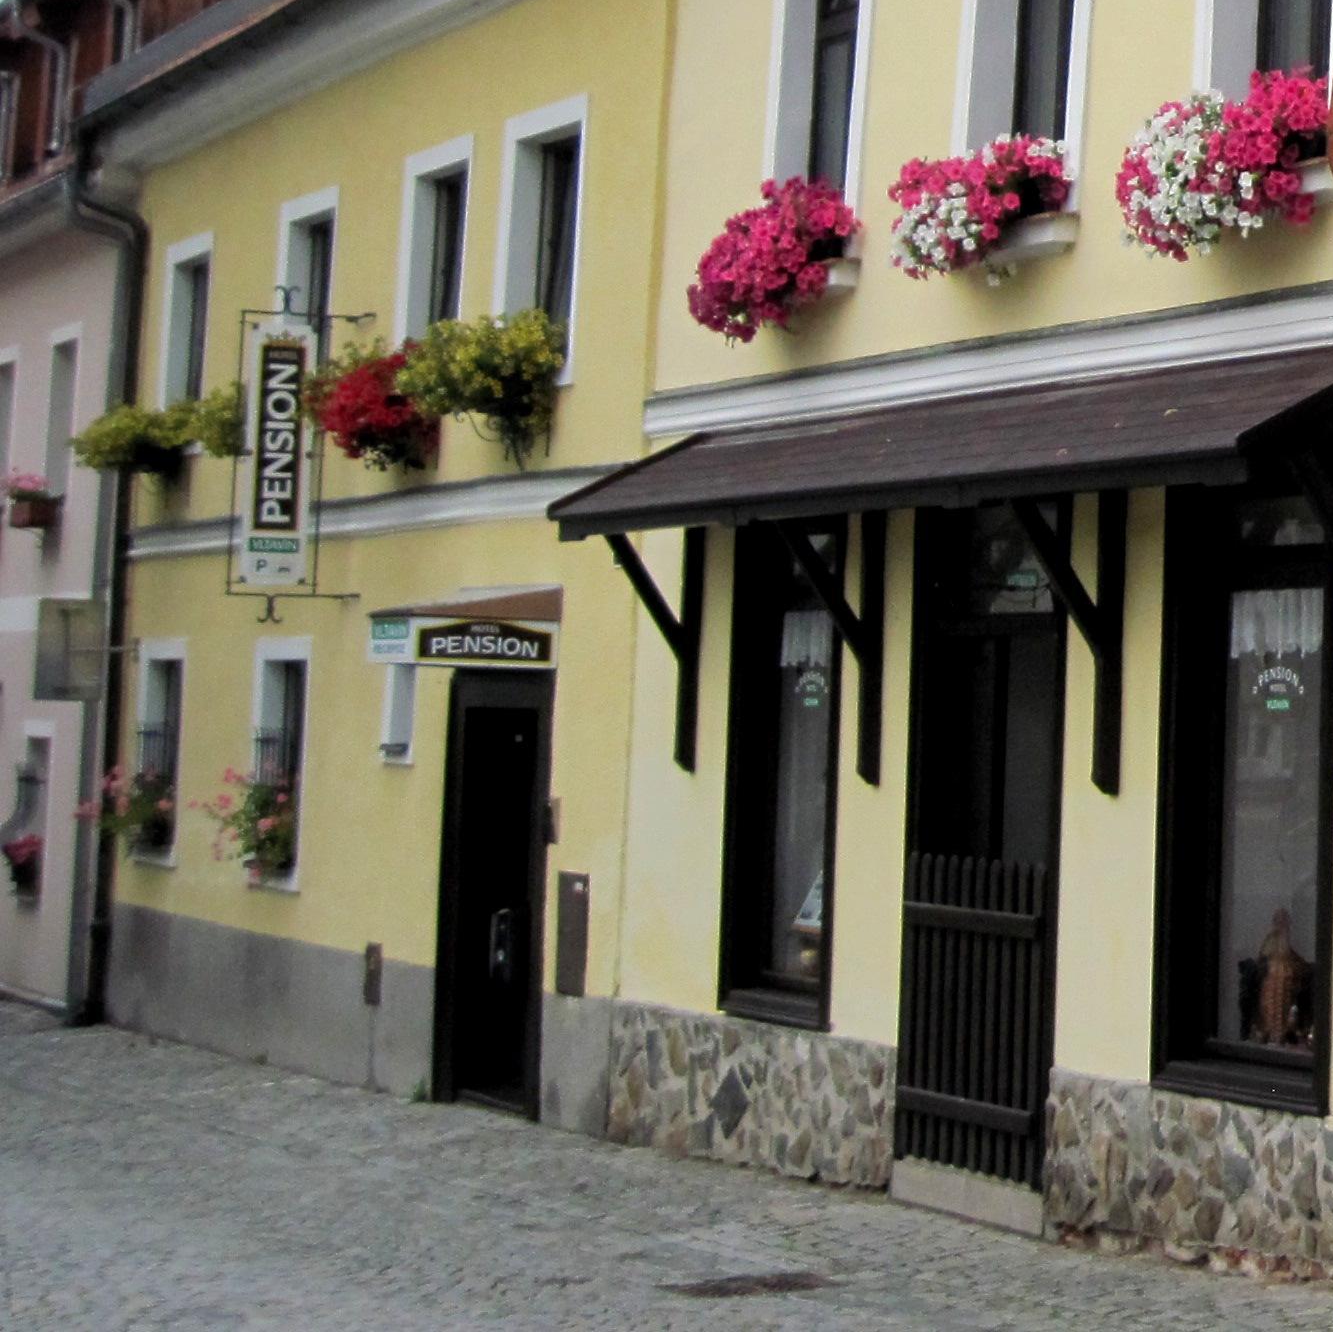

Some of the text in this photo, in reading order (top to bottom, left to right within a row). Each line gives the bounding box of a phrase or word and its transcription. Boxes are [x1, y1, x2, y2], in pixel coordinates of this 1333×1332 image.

[261, 363, 298, 523] PENSION
[431, 636, 539, 658] PENSION
[1257, 666, 1300, 687] PENSION
